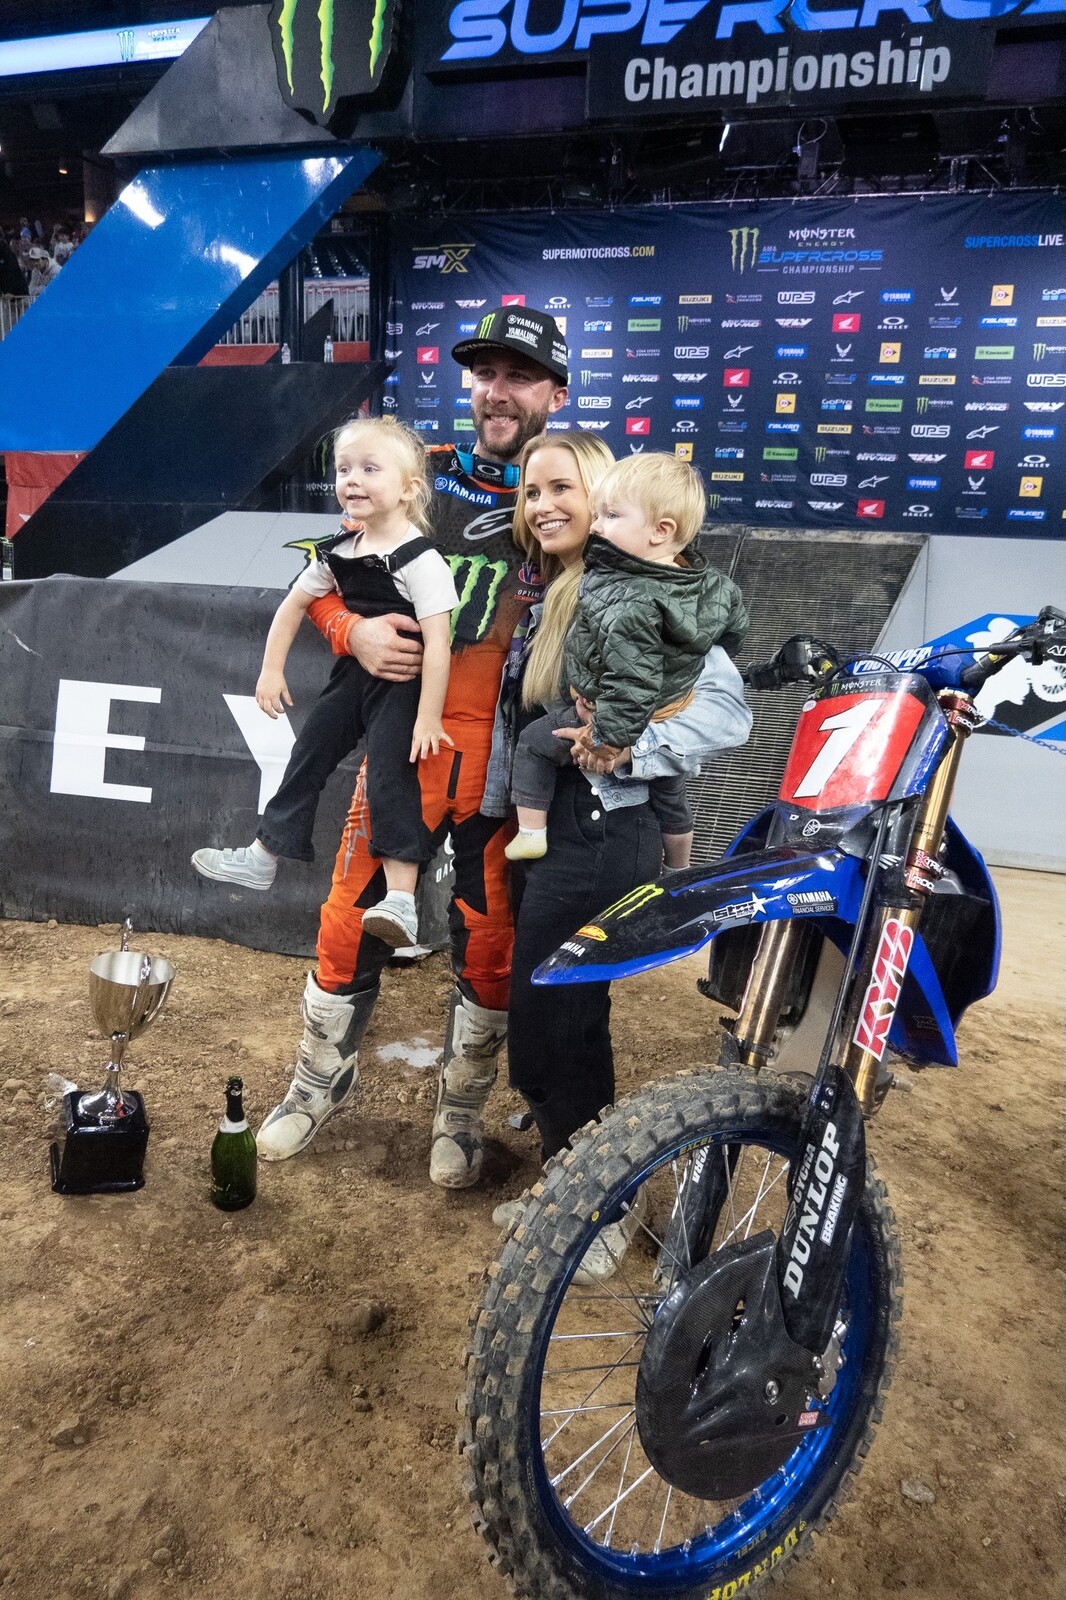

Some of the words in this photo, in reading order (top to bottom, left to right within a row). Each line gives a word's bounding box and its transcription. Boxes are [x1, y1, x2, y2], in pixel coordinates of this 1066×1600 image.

[440, 0, 1066, 61] SUPER
[624, 35, 951, 104] Championship
[788, 227, 856, 240] MONSTER
[542, 245, 655, 260] SUPERMOTOCROSS.COM
[758, 250, 884, 263] SUPERCROSS
[782, 265, 855, 274] CHAMPIONSHIP
[777, 291, 816, 305] WPS
[516, 317, 543, 335] YAMAHA
[508, 327, 539, 344] YAMALUBE
[674, 346, 710, 359] WPS
[1026, 373, 1066, 388] WPS
[577, 396, 612, 409] WPS
[911, 424, 951, 438] WPS
[305, 482, 336, 492] MONST
[810, 473, 848, 487] WPS
[448, 480, 492, 505] YAMAHA
[841, 678, 882, 691] MONSTER
[794, 699, 884, 798] 1
[796, 890, 833, 904] YAMAHA
[792, 906, 814, 914] FINANCIAL
[814, 904, 835, 912] SERVICES
[853, 918, 914, 1062] KYB
[793, 1142, 817, 1204] CYCRA
[782, 1121, 840, 1300] DUNLOP
[821, 1175, 847, 1245] BRAKING
